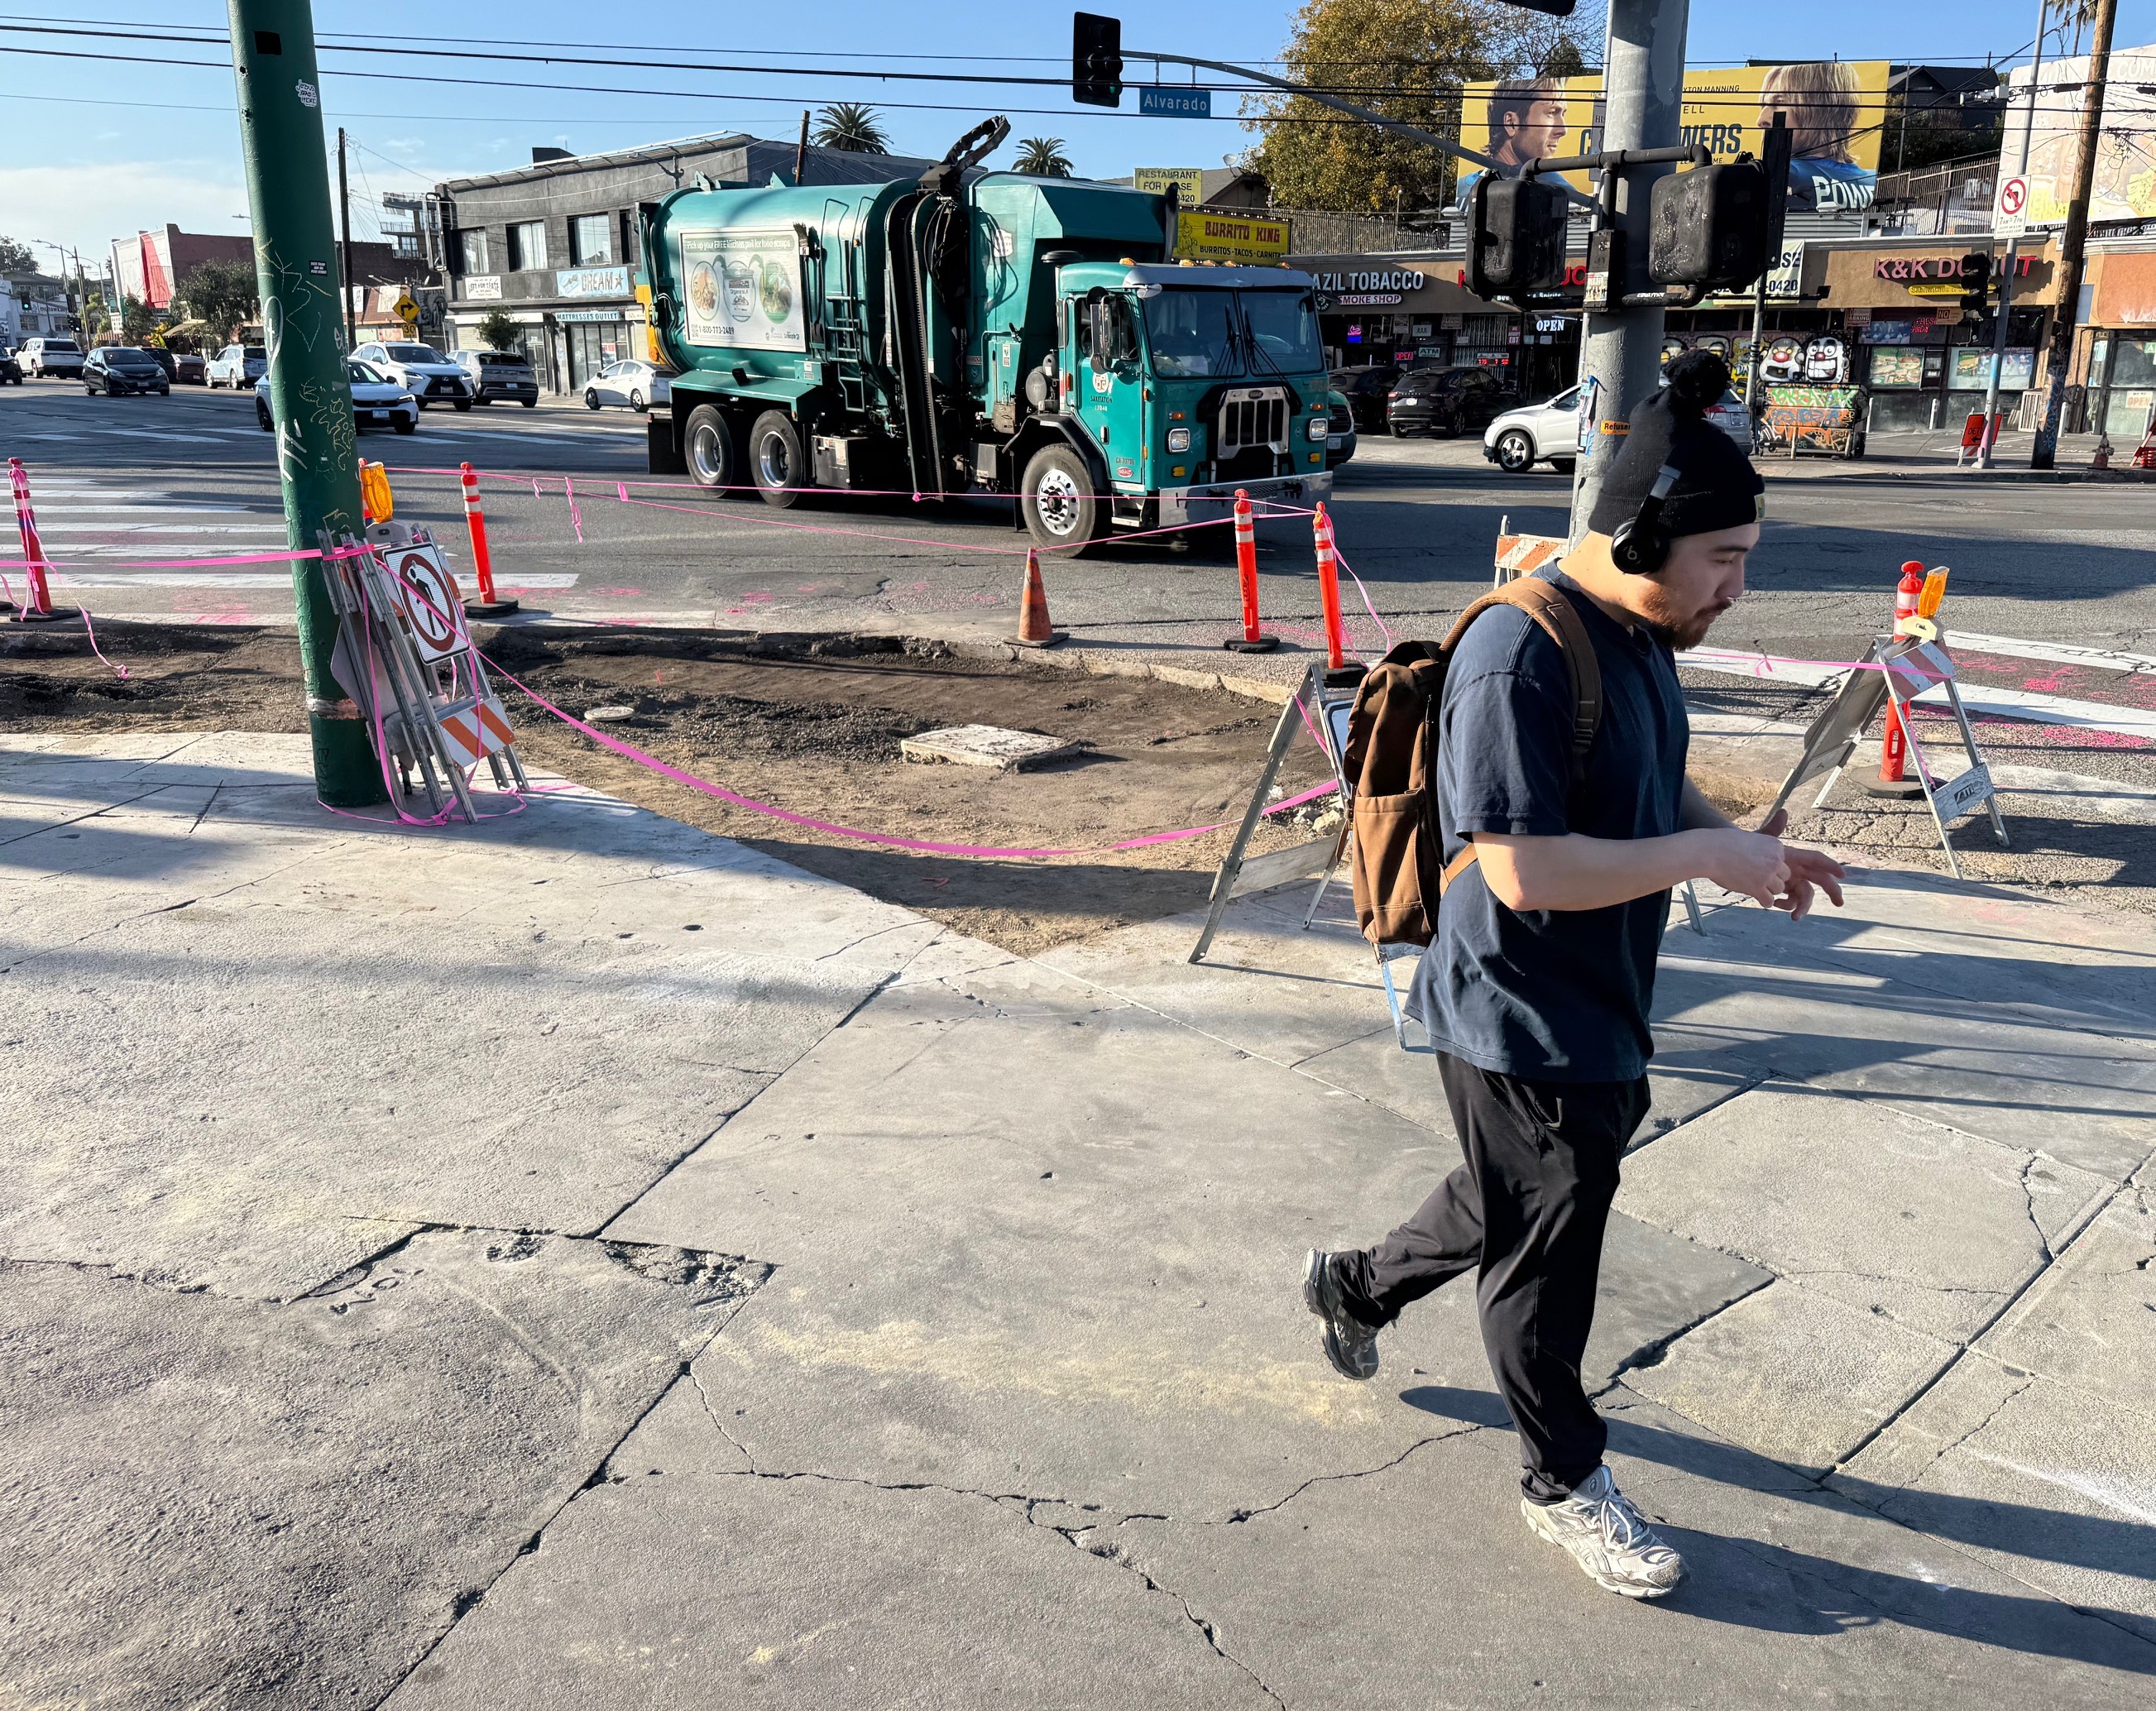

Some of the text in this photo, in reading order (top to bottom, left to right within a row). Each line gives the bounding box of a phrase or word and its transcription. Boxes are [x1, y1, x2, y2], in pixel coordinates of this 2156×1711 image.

[1144, 93, 1207, 111] Alvarado
[1679, 123, 1742, 154] WERS
[1138, 170, 1197, 180] RESTAURANT
[1143, 181, 1162, 190] FOR
[1205, 221, 1281, 242] BURRITO KING
[1200, 245, 1231, 256] BURRITOS
[1234, 248, 1253, 257] TACOS
[1873, 257, 1928, 279] K&K
[582, 271, 613, 291] DREAM
[1349, 271, 1424, 291] TOBACCO
[1338, 295, 1400, 304] SMOKE SHOP
[1938, 310, 1949, 319] NO
[404, 325, 414, 333] 30
[1536, 319, 1564, 332] OPEN
[2148, 343, 2154, 352] A
[2127, 395, 2151, 407] OPEN
